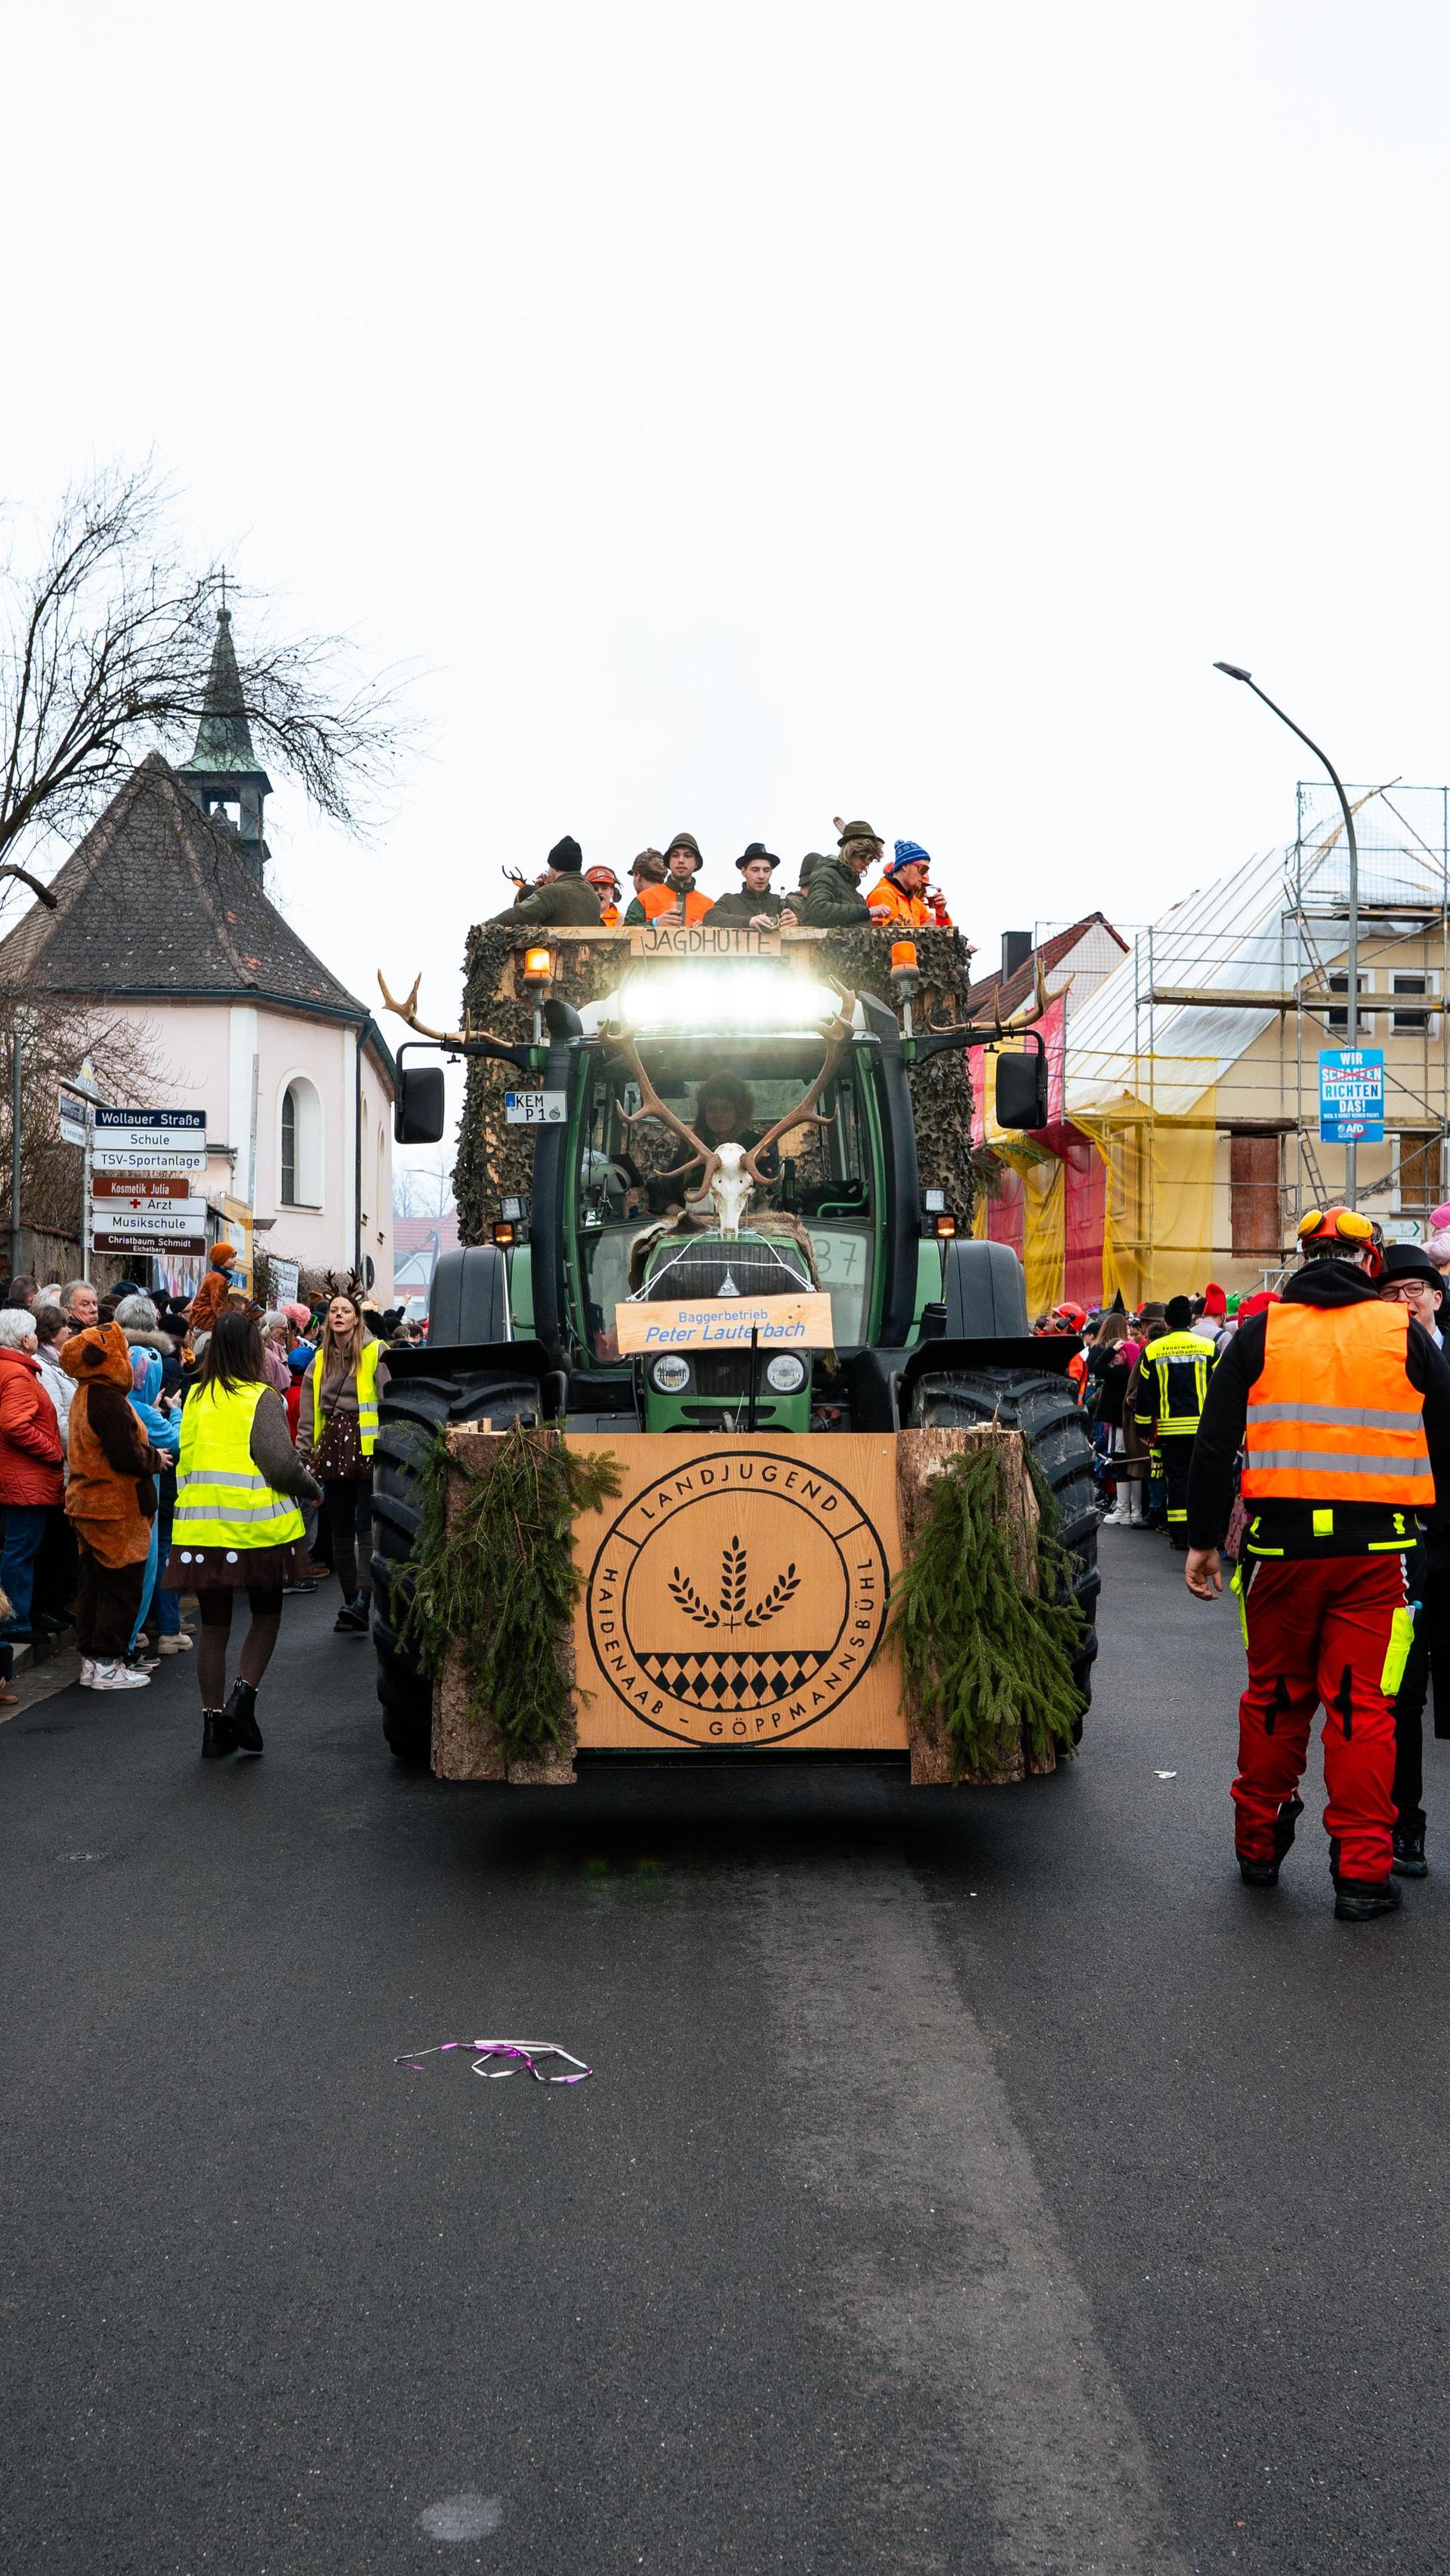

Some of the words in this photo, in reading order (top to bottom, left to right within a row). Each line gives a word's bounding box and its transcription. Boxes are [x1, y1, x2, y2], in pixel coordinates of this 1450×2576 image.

[645, 929, 771, 954] JAGDHÜTTE
[1340, 1052, 1363, 1065] WIR
[1325, 1085, 1378, 1098] RICHTEN
[516, 1095, 544, 1108] KEM
[1339, 1100, 1365, 1112] DAS!
[101, 1113, 155, 1124] Wollauer
[161, 1114, 200, 1126] Straße
[526, 1108, 533, 1120] P
[538, 1108, 546, 1120] 1
[1346, 1123, 1364, 1133] AfD
[131, 1134, 170, 1145] Schule
[101, 1154, 200, 1168] TSV-Sportanlage
[111, 1182, 147, 1194] Kosmetik
[150, 1184, 170, 1194] Julia
[147, 1199, 172, 1209] Arzt
[113, 1216, 186, 1229] Musikschule
[108, 1236, 155, 1246] Christbaum
[158, 1238, 191, 1247] Schmidt
[133, 1246, 165, 1254] Eichelberg
[679, 1309, 768, 1324] Baggerbetrieb
[645, 1327, 696, 1342] Peter
[640, 1463, 838, 1519] LANDJUGEND
[599, 1568, 664, 1715] HAIDENAAB
[709, 1558, 875, 1736] GÖPPMANNSBÜHL
